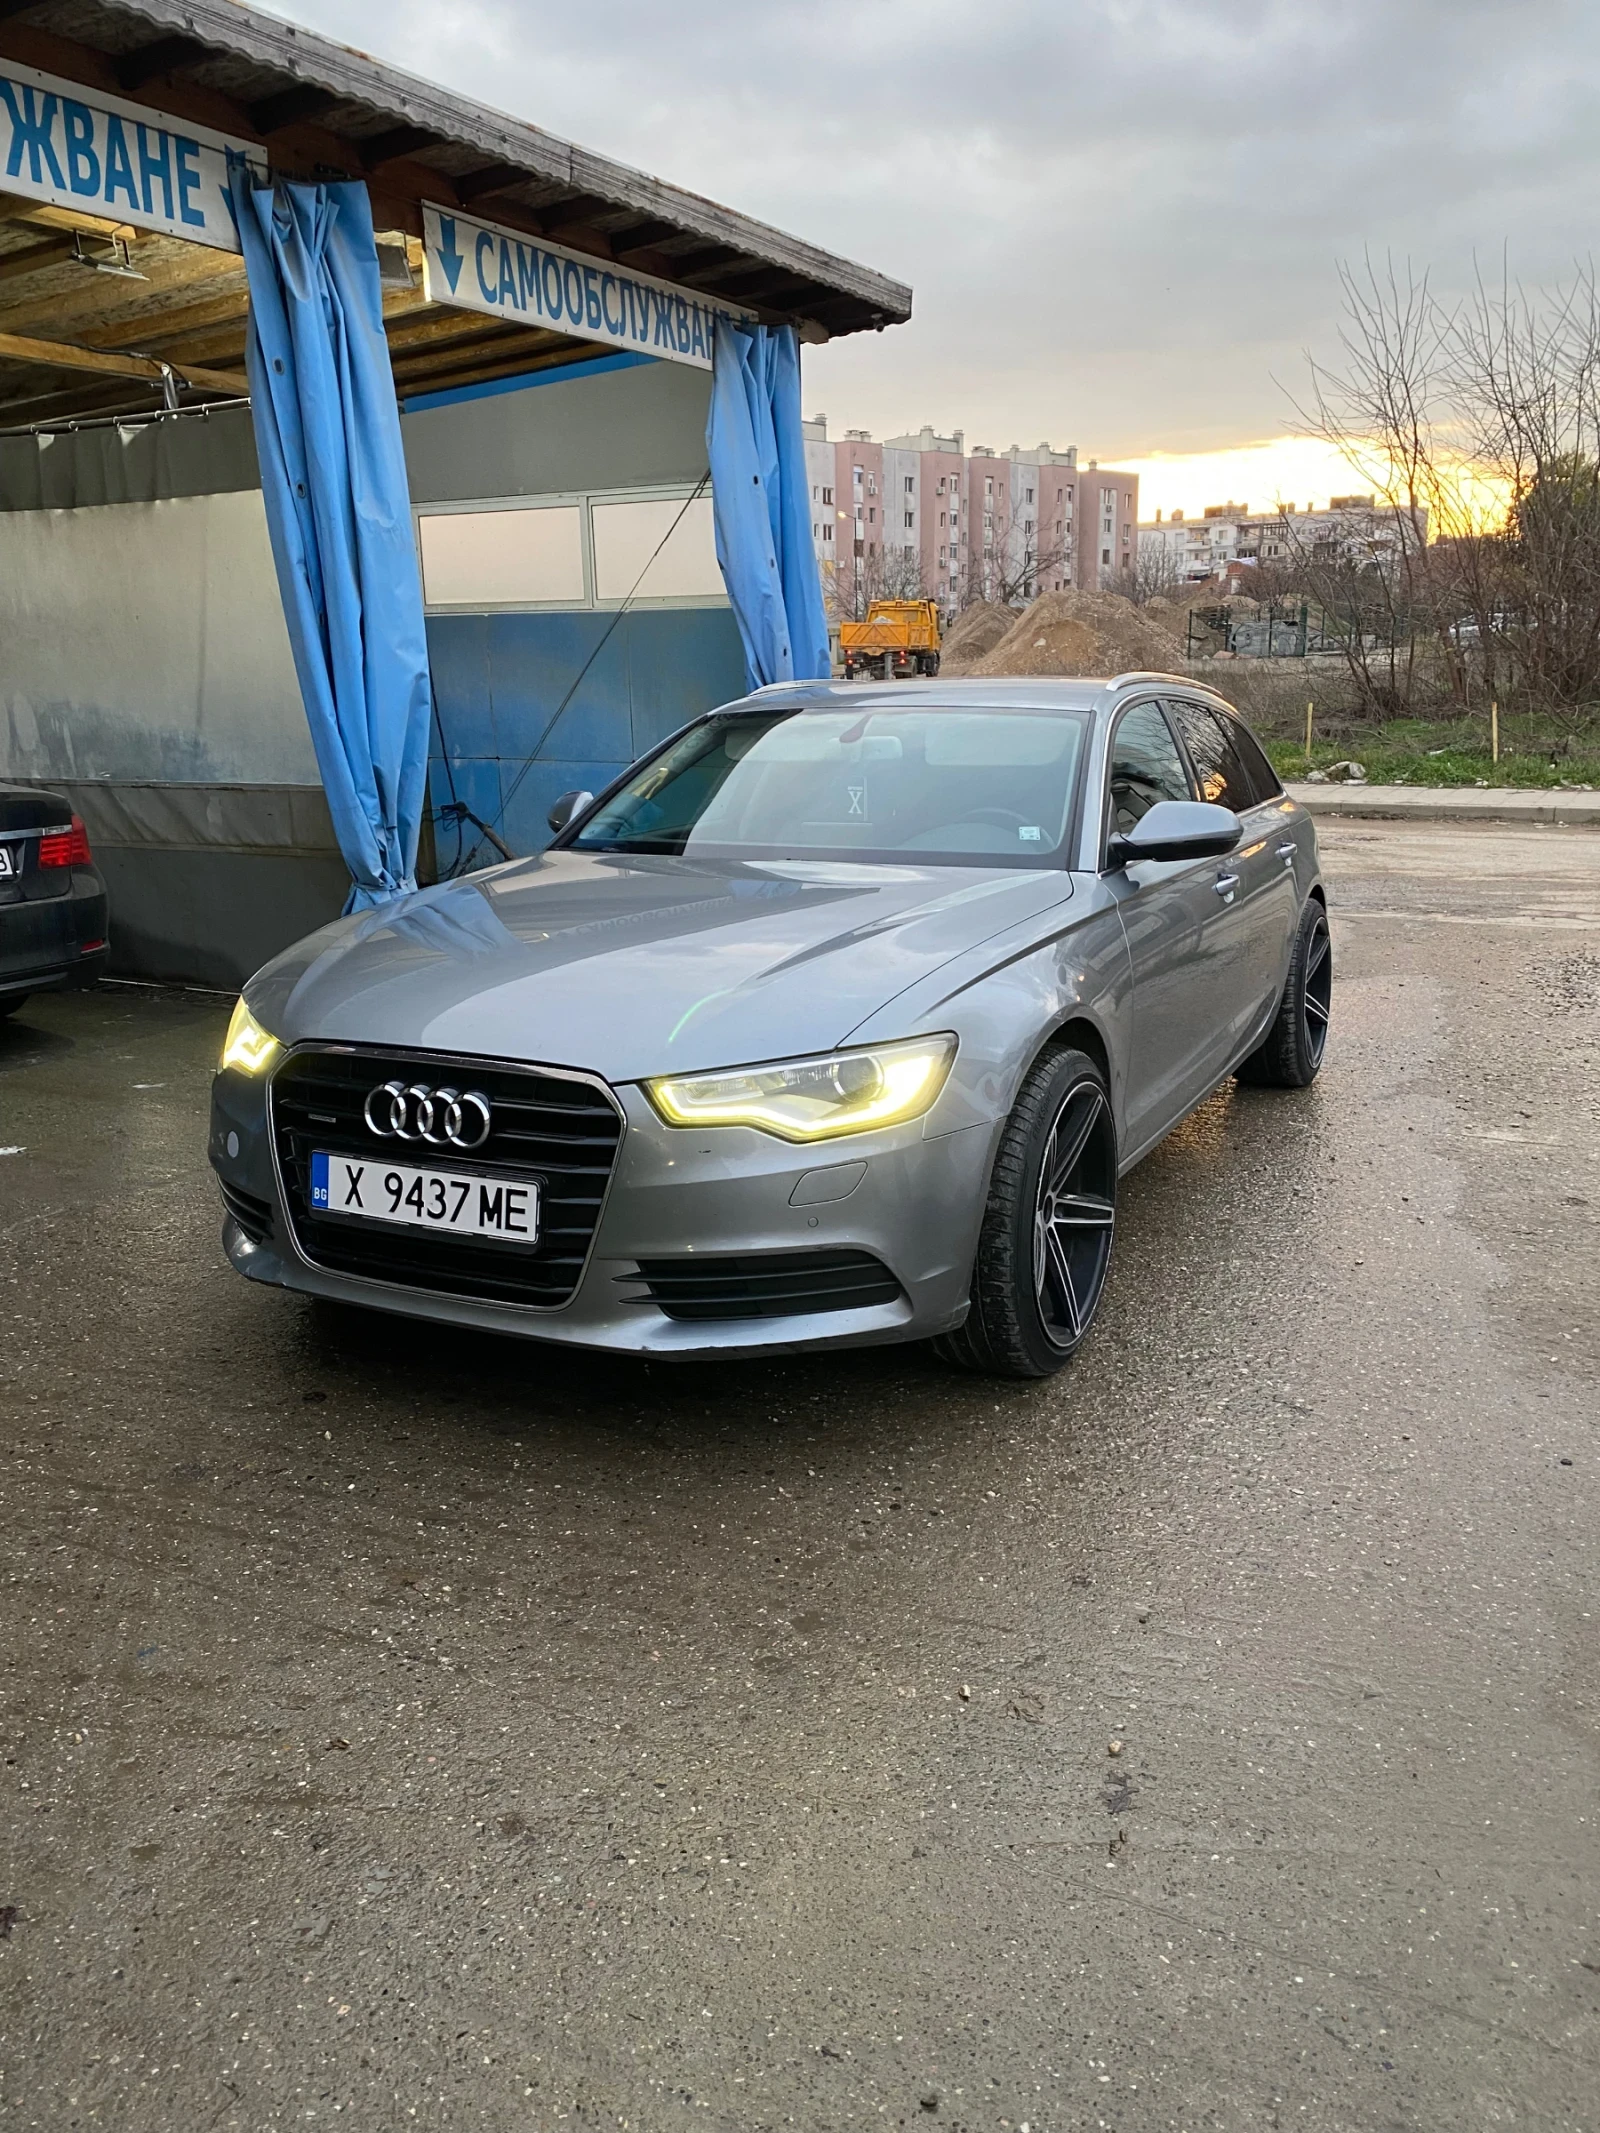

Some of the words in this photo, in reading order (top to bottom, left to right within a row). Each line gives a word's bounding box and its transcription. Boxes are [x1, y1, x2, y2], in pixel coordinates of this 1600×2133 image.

[475, 231, 729, 360] САМООБСЛУЖВАН
[314, 1187, 328, 1201] BG
[345, 1164, 364, 1208] X
[384, 1172, 470, 1223] 9437
[479, 1186, 528, 1233] ME
